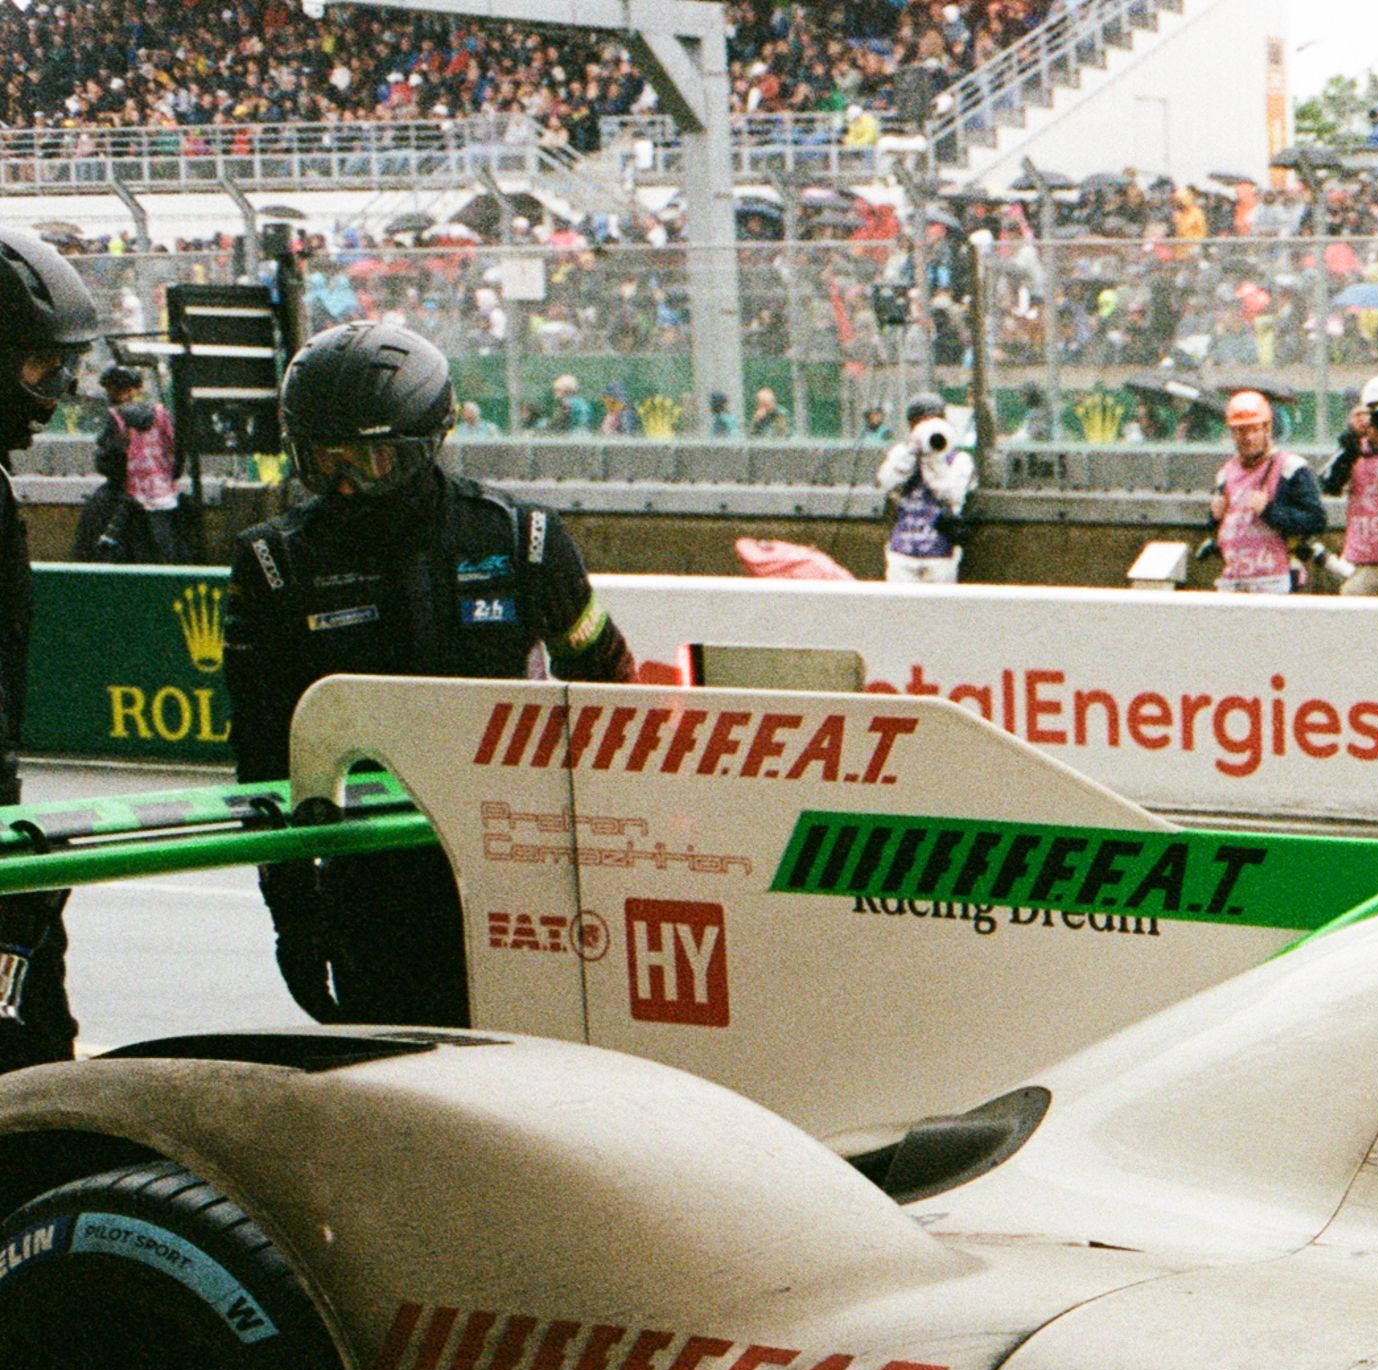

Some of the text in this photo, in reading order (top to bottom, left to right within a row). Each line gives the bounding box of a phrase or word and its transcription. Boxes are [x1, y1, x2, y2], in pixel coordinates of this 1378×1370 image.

[106, 684, 233, 742] ROL
[83, 1224, 193, 1268] PILOT SPORT
